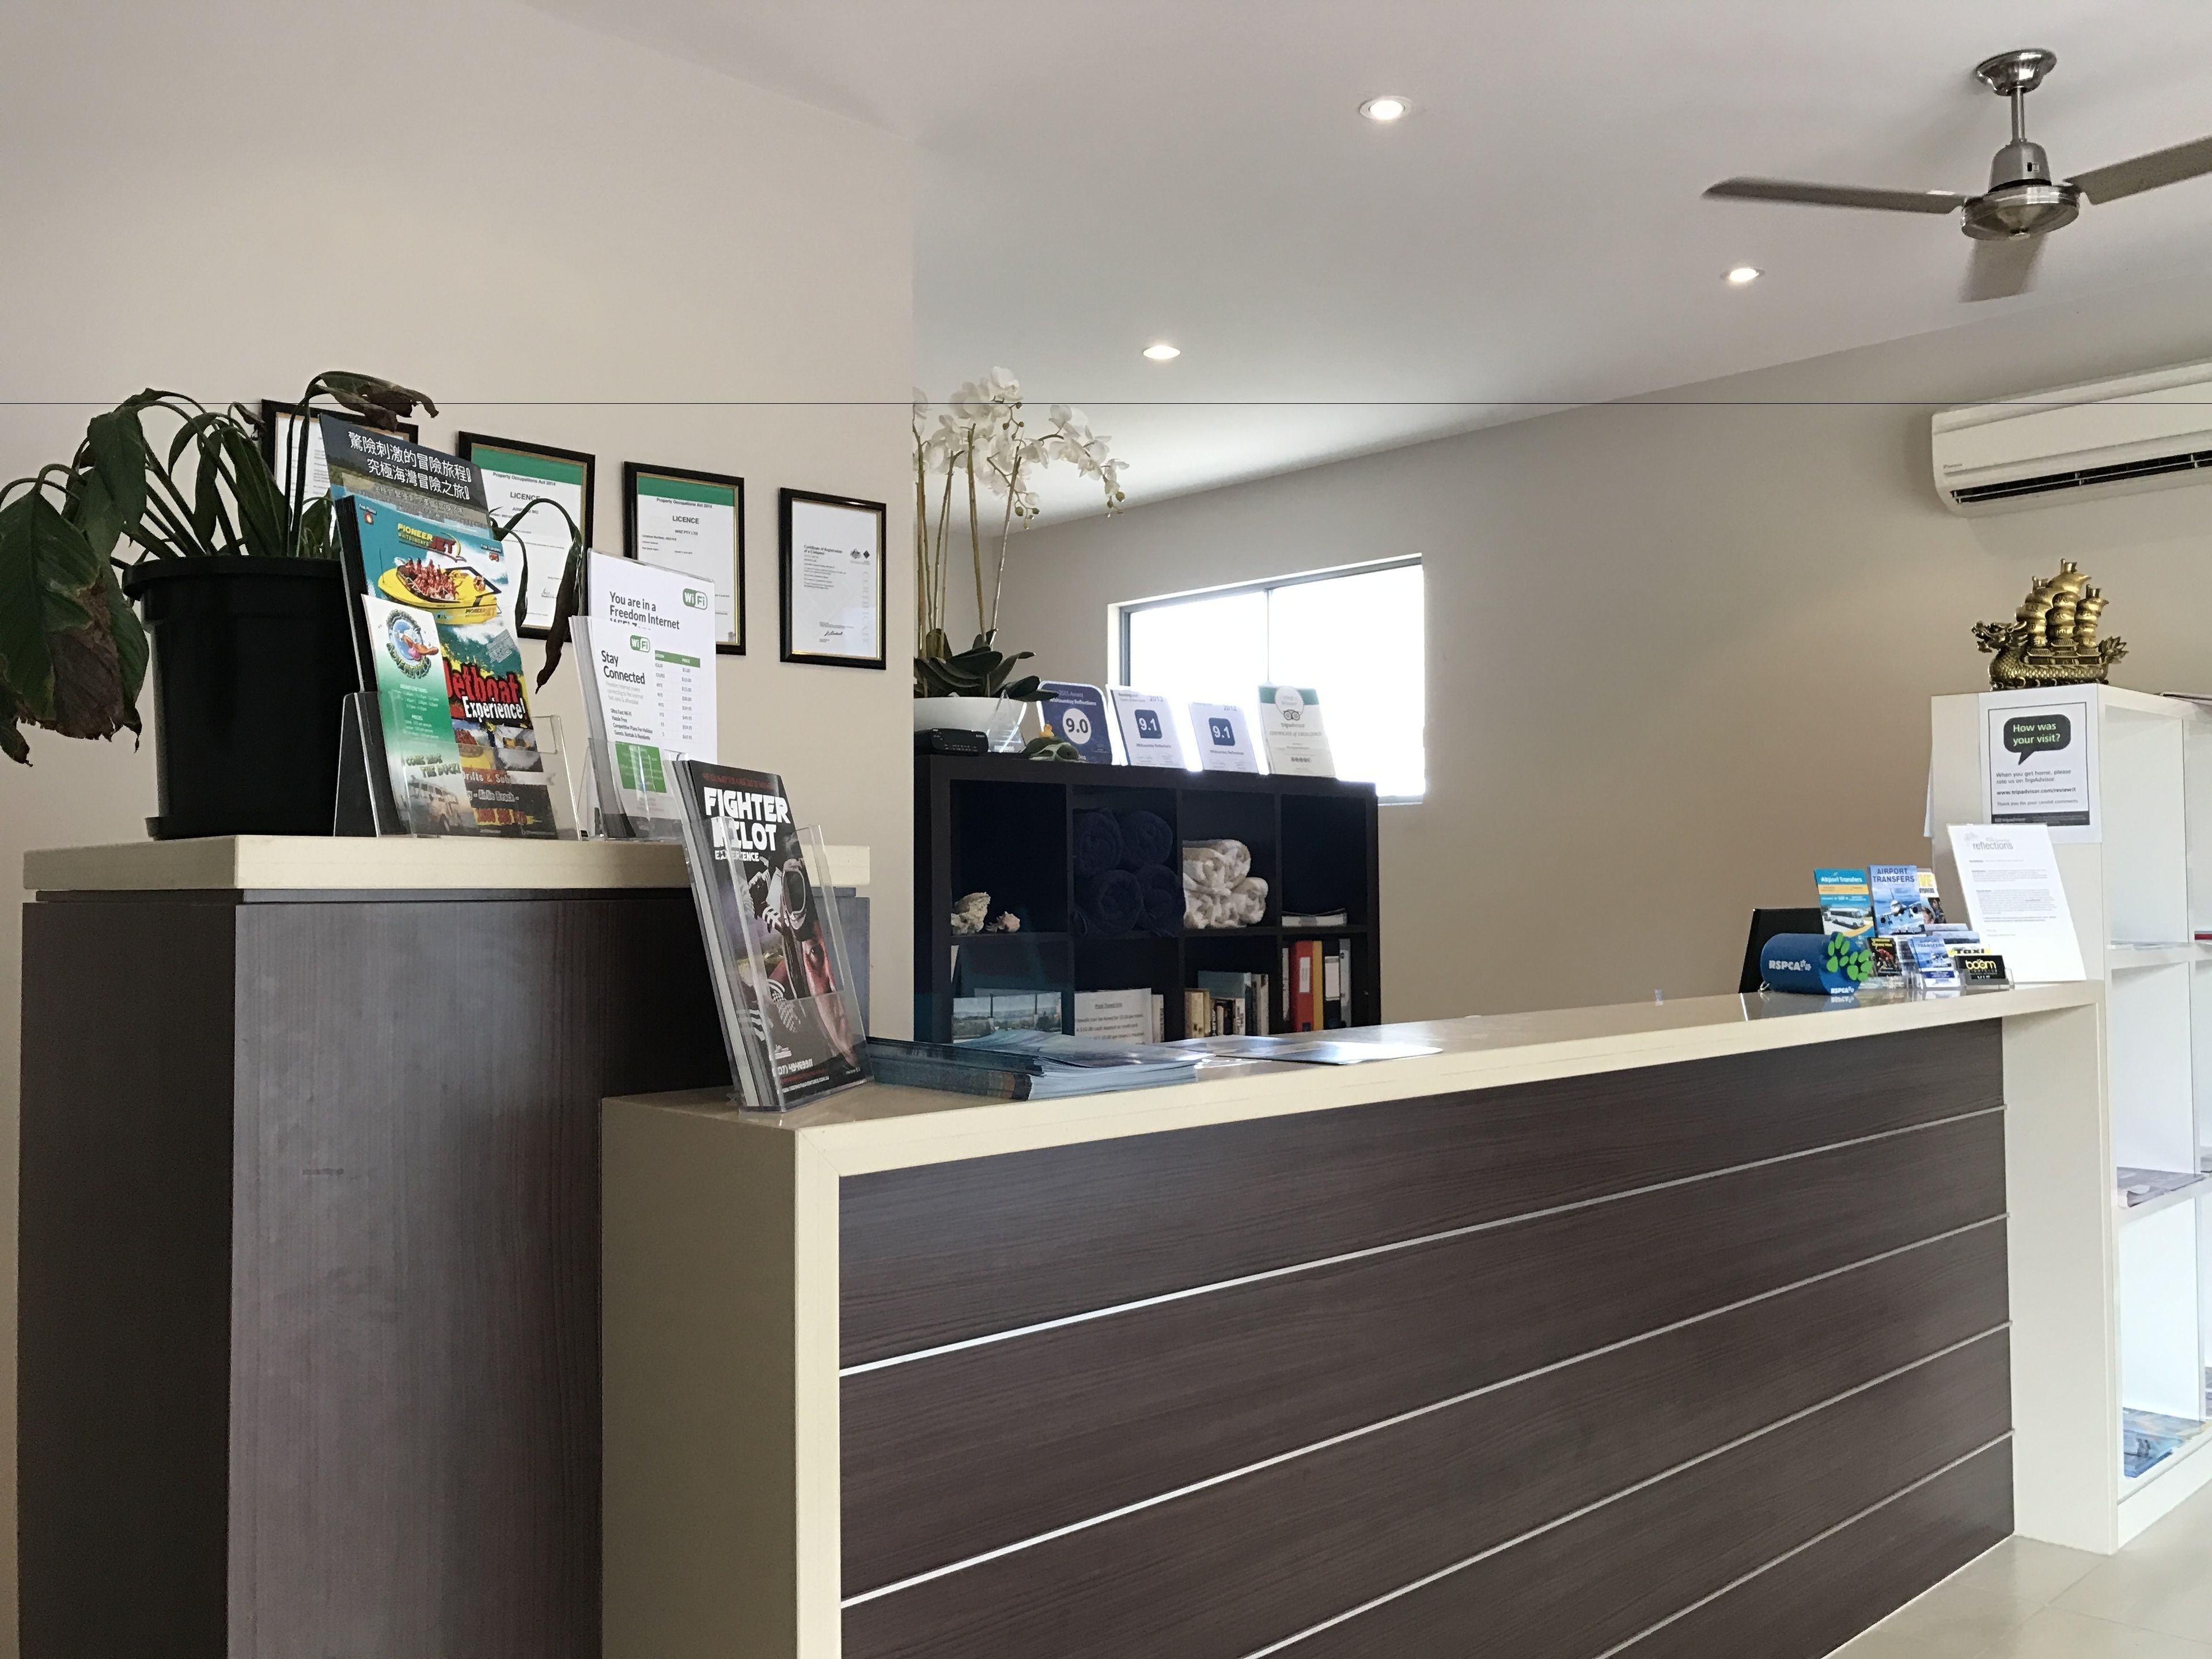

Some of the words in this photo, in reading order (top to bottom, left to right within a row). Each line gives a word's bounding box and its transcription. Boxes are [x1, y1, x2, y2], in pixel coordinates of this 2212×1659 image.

[512, 475, 537, 483] Occupations
[672, 516, 699, 524] LICENCE
[397, 523, 434, 541] PIONEER
[609, 591, 626, 605] You
[627, 599, 641, 608] are
[642, 599, 650, 611] in
[652, 604, 656, 612] a
[610, 604, 646, 623] Freedom
[648, 613, 680, 630] Internet
[601, 650, 619, 666] Stay
[603, 666, 646, 685] Connected
[462, 696, 526, 723] Experience!
[1066, 718, 1089, 733] 9.0
[1139, 717, 1157, 731] 9.1
[2013, 724, 2035, 733] How
[2037, 722, 2056, 732] was
[1213, 725, 1230, 738] 9.1
[2013, 734, 2035, 747] your
[2036, 733, 2061, 743] visit?
[486, 773, 493, 782] &
[478, 790, 495, 801] Airlie
[495, 791, 516, 802] Beach
[704, 786, 791, 824] FIGHTER
[1972, 842, 2014, 850] reflections
[714, 850, 760, 862] EXERIENCE
[1768, 960, 1801, 971] RSPCA
[1965, 959, 1997, 970] boom
